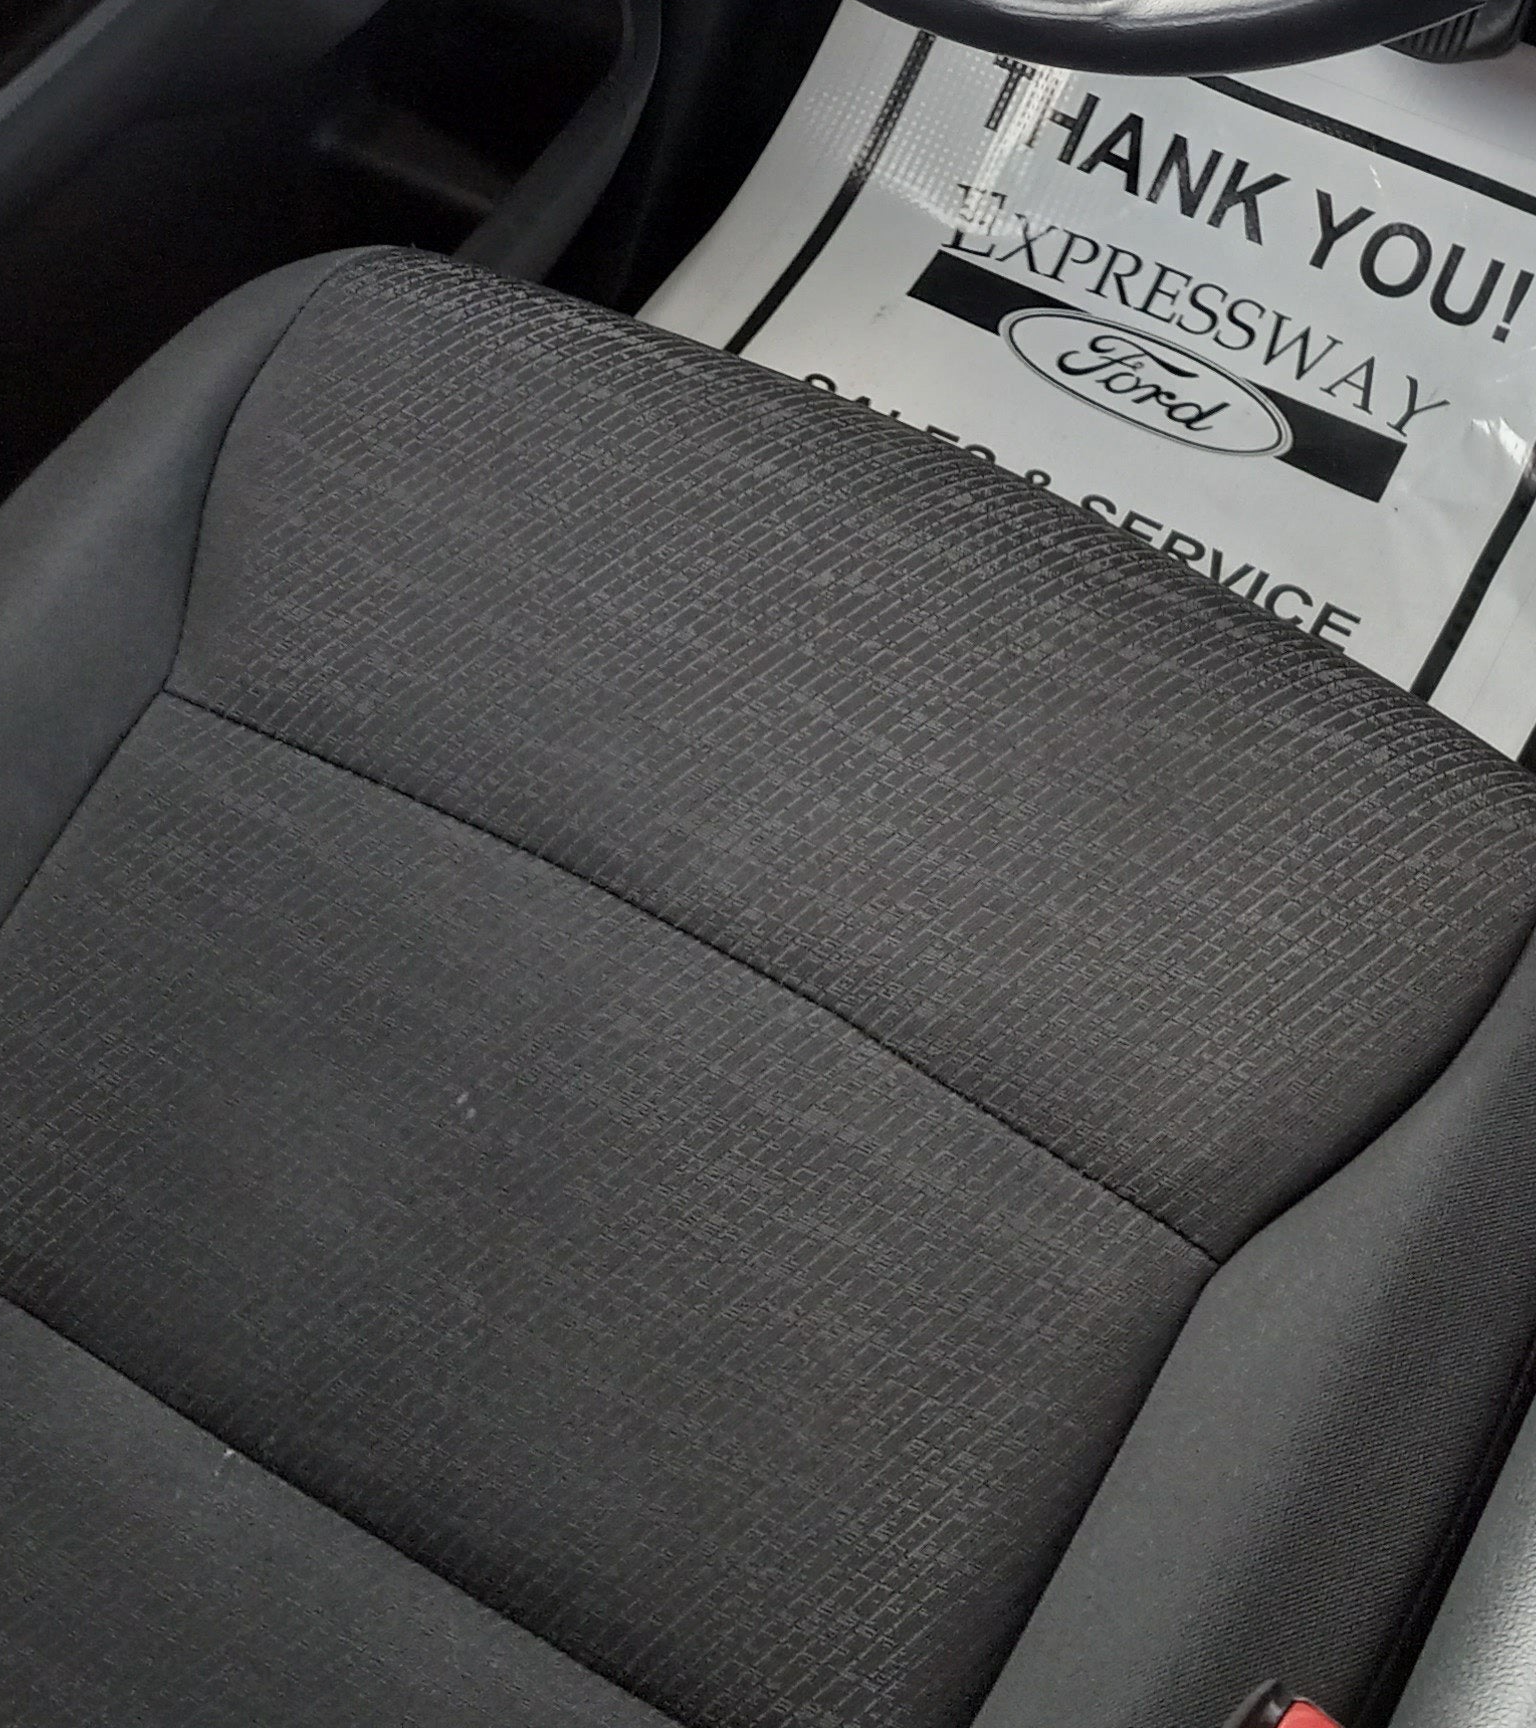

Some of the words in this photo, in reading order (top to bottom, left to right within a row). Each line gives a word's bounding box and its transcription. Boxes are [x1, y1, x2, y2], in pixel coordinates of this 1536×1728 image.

[941, 183, 1451, 438] EXPRESSWAY
[1308, 188, 1535, 345] YOU!
[1056, 334, 1232, 433] Ford
